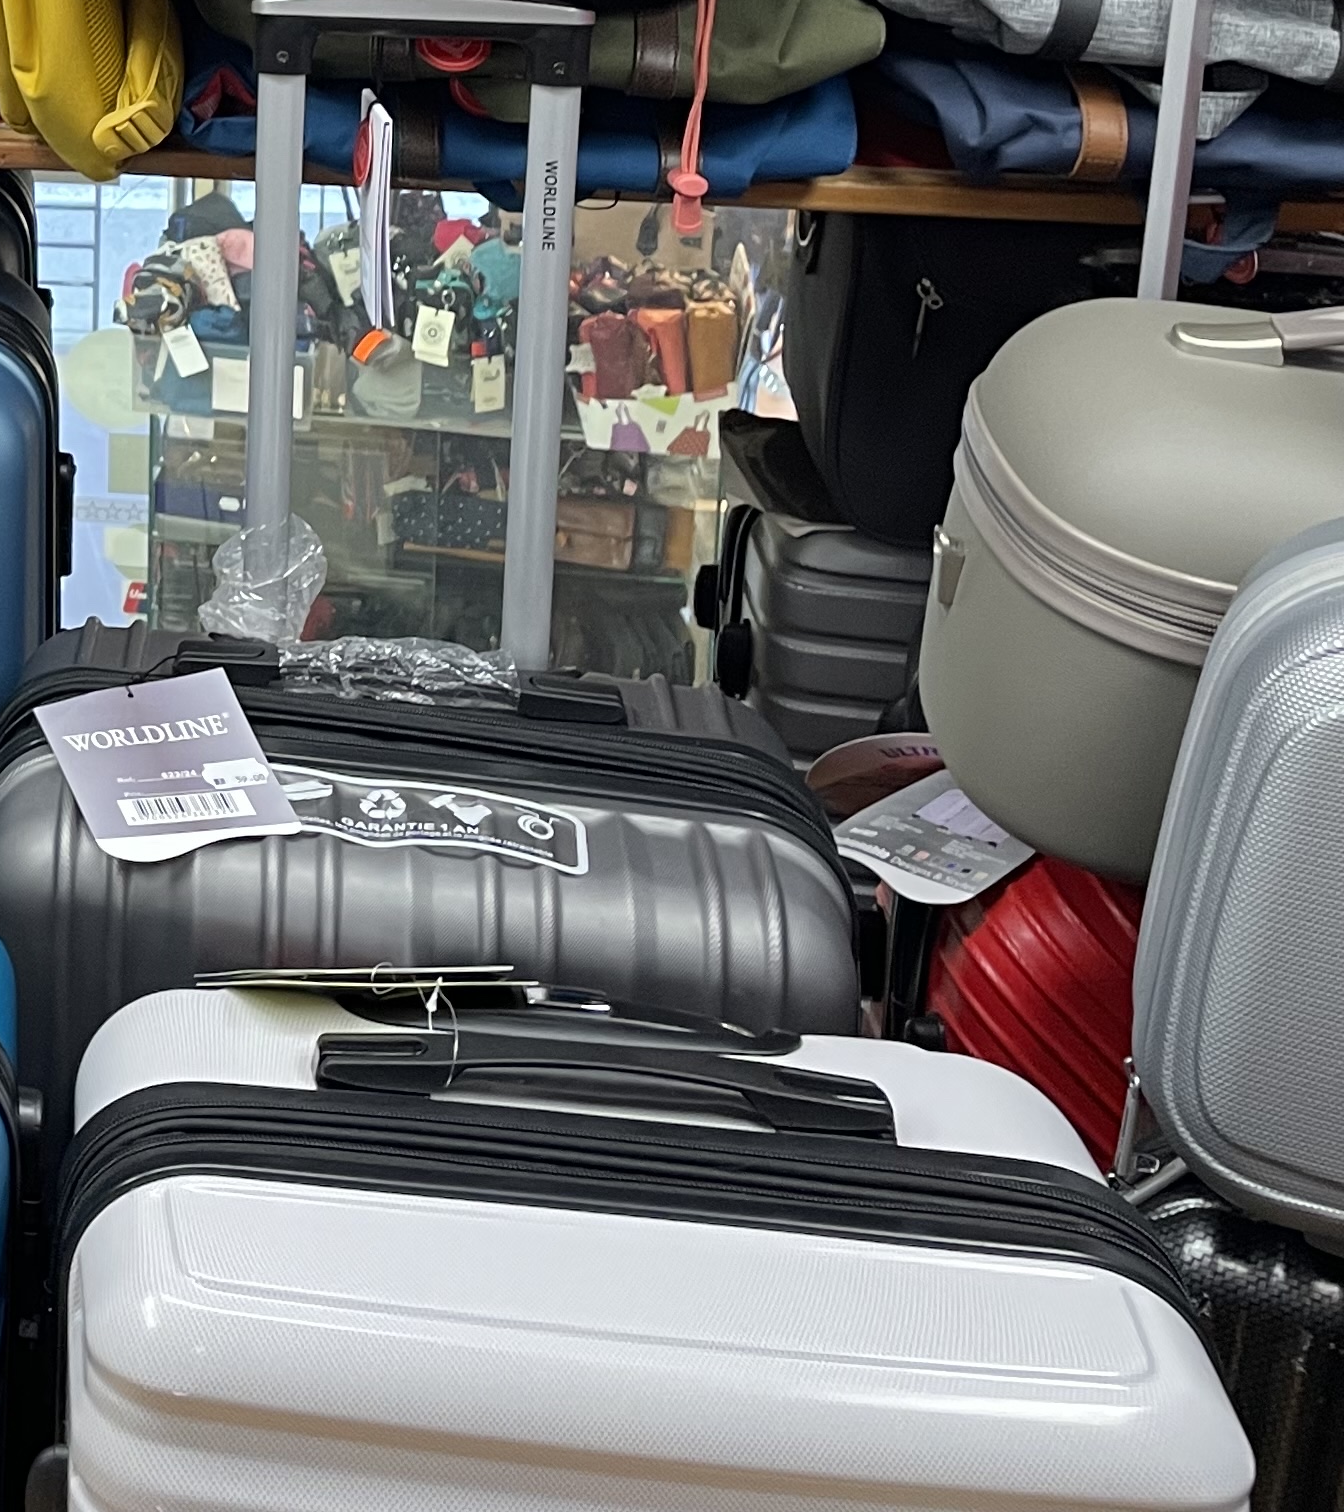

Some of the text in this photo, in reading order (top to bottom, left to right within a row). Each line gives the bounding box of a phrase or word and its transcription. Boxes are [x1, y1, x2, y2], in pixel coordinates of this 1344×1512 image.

[542, 160, 559, 251] WORLDLINE
[62, 714, 229, 752] WORLDLINE
[341, 817, 435, 832] GARANTIE
[453, 824, 479, 834] AN
